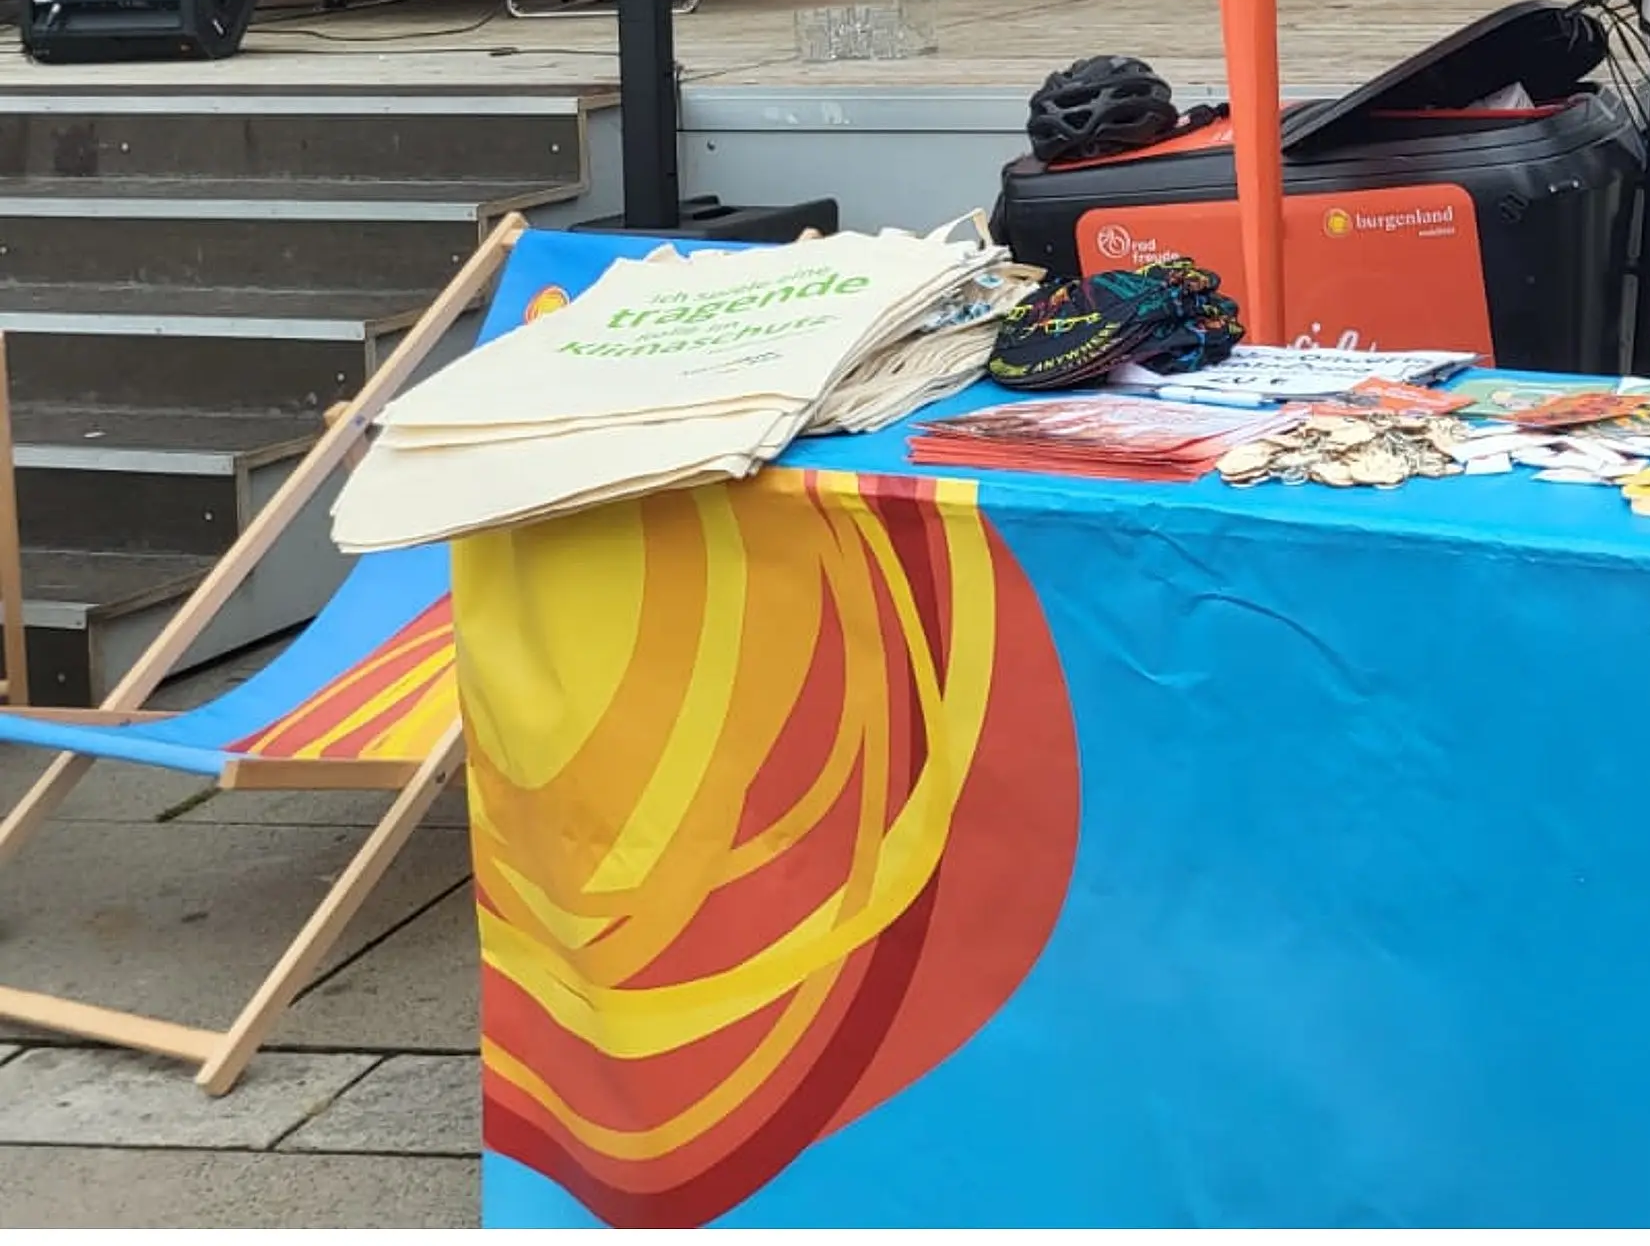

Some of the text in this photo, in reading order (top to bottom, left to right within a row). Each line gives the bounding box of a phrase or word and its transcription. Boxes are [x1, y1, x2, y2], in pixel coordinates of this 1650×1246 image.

[1355, 205, 1454, 231] burgenland
[1131, 238, 1156, 252] rad
[606, 271, 871, 329] tragende
